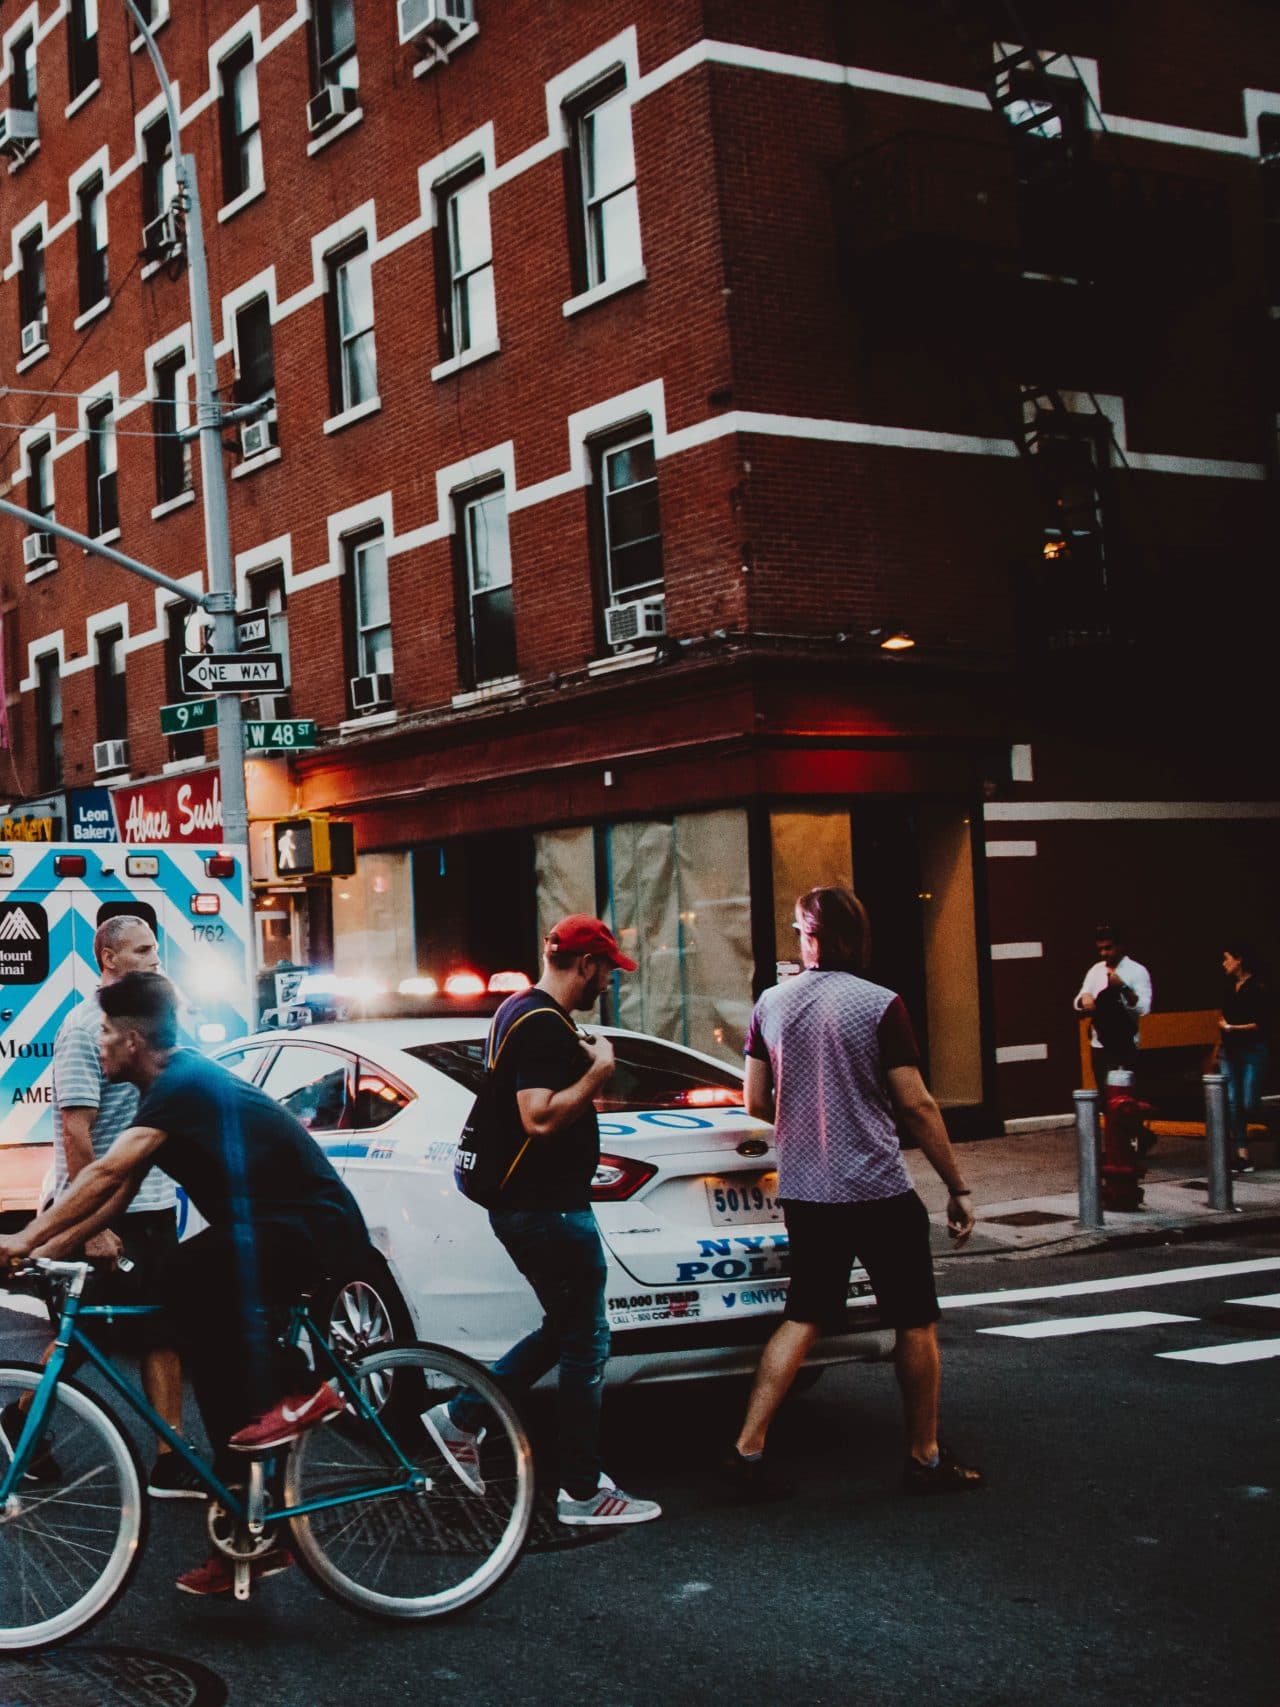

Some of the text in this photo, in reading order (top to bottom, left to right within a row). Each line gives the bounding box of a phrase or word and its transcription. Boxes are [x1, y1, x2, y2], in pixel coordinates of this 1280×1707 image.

[240, 623, 261, 638] WAY
[198, 665, 270, 681] ONE WAY
[176, 705, 204, 728] 9 AV
[251, 723, 310, 746] W 48 ST
[79, 806, 109, 822] Leon
[176, 777, 224, 836] Sush
[73, 824, 117, 843] Bakery
[192, 925, 225, 943] 1762
[714, 1186, 763, 1212] 5019
[696, 1235, 790, 1257] NYP
[608, 1295, 652, 1310] $10,000
